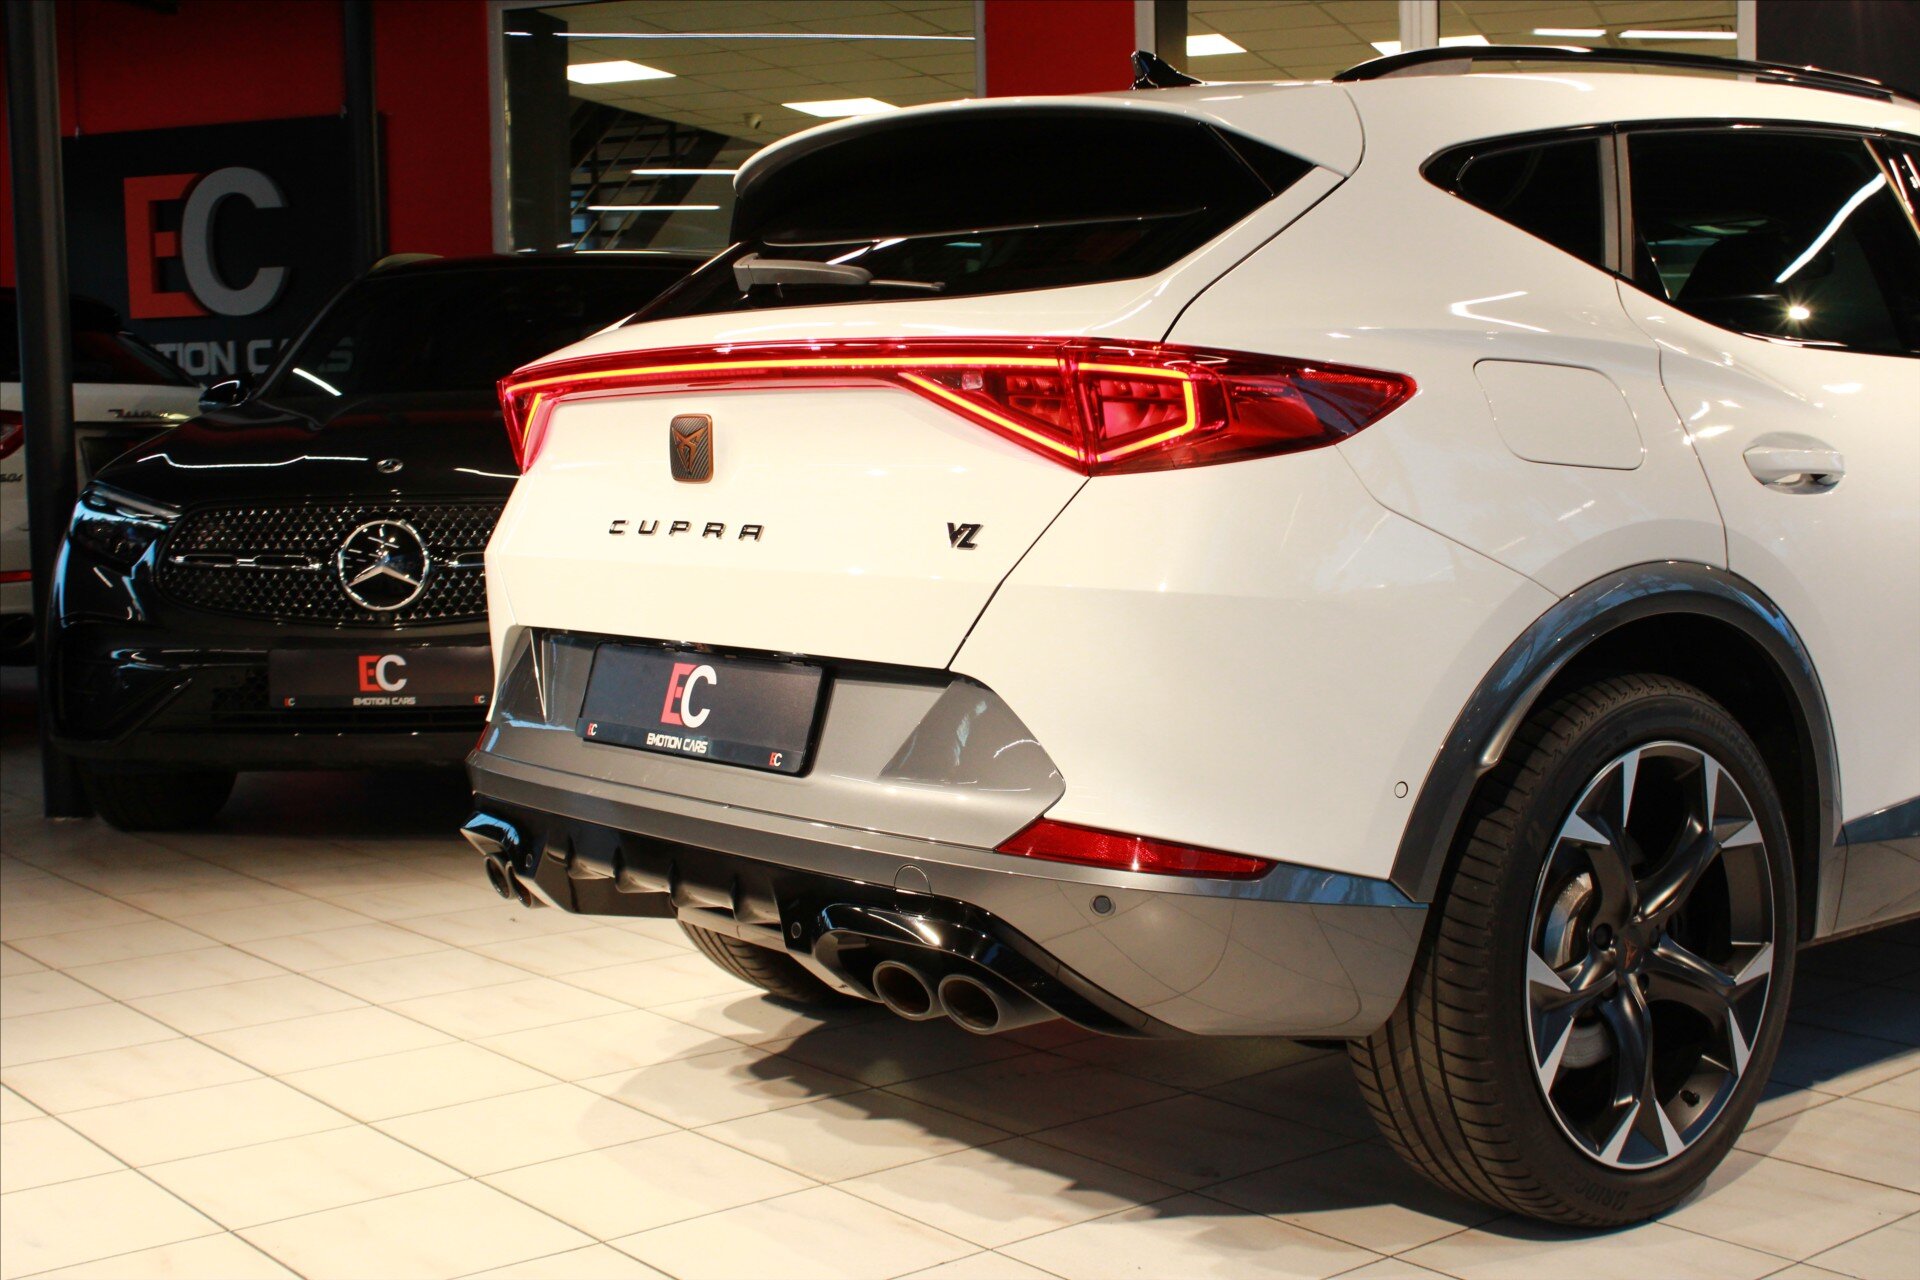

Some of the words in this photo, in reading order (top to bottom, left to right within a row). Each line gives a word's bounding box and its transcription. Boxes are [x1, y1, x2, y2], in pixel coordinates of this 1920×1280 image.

[123, 166, 289, 319] EC
[154, 340, 238, 376] TION
[246, 337, 355, 374] CS
[608, 519, 765, 541] CUPRA
[946, 521, 984, 551] VZ
[358, 654, 407, 691] EC
[391, 696, 416, 706] CARS
[660, 662, 717, 728] EC
[646, 732, 683, 750] EMOTION
[683, 738, 709, 754] CARS
